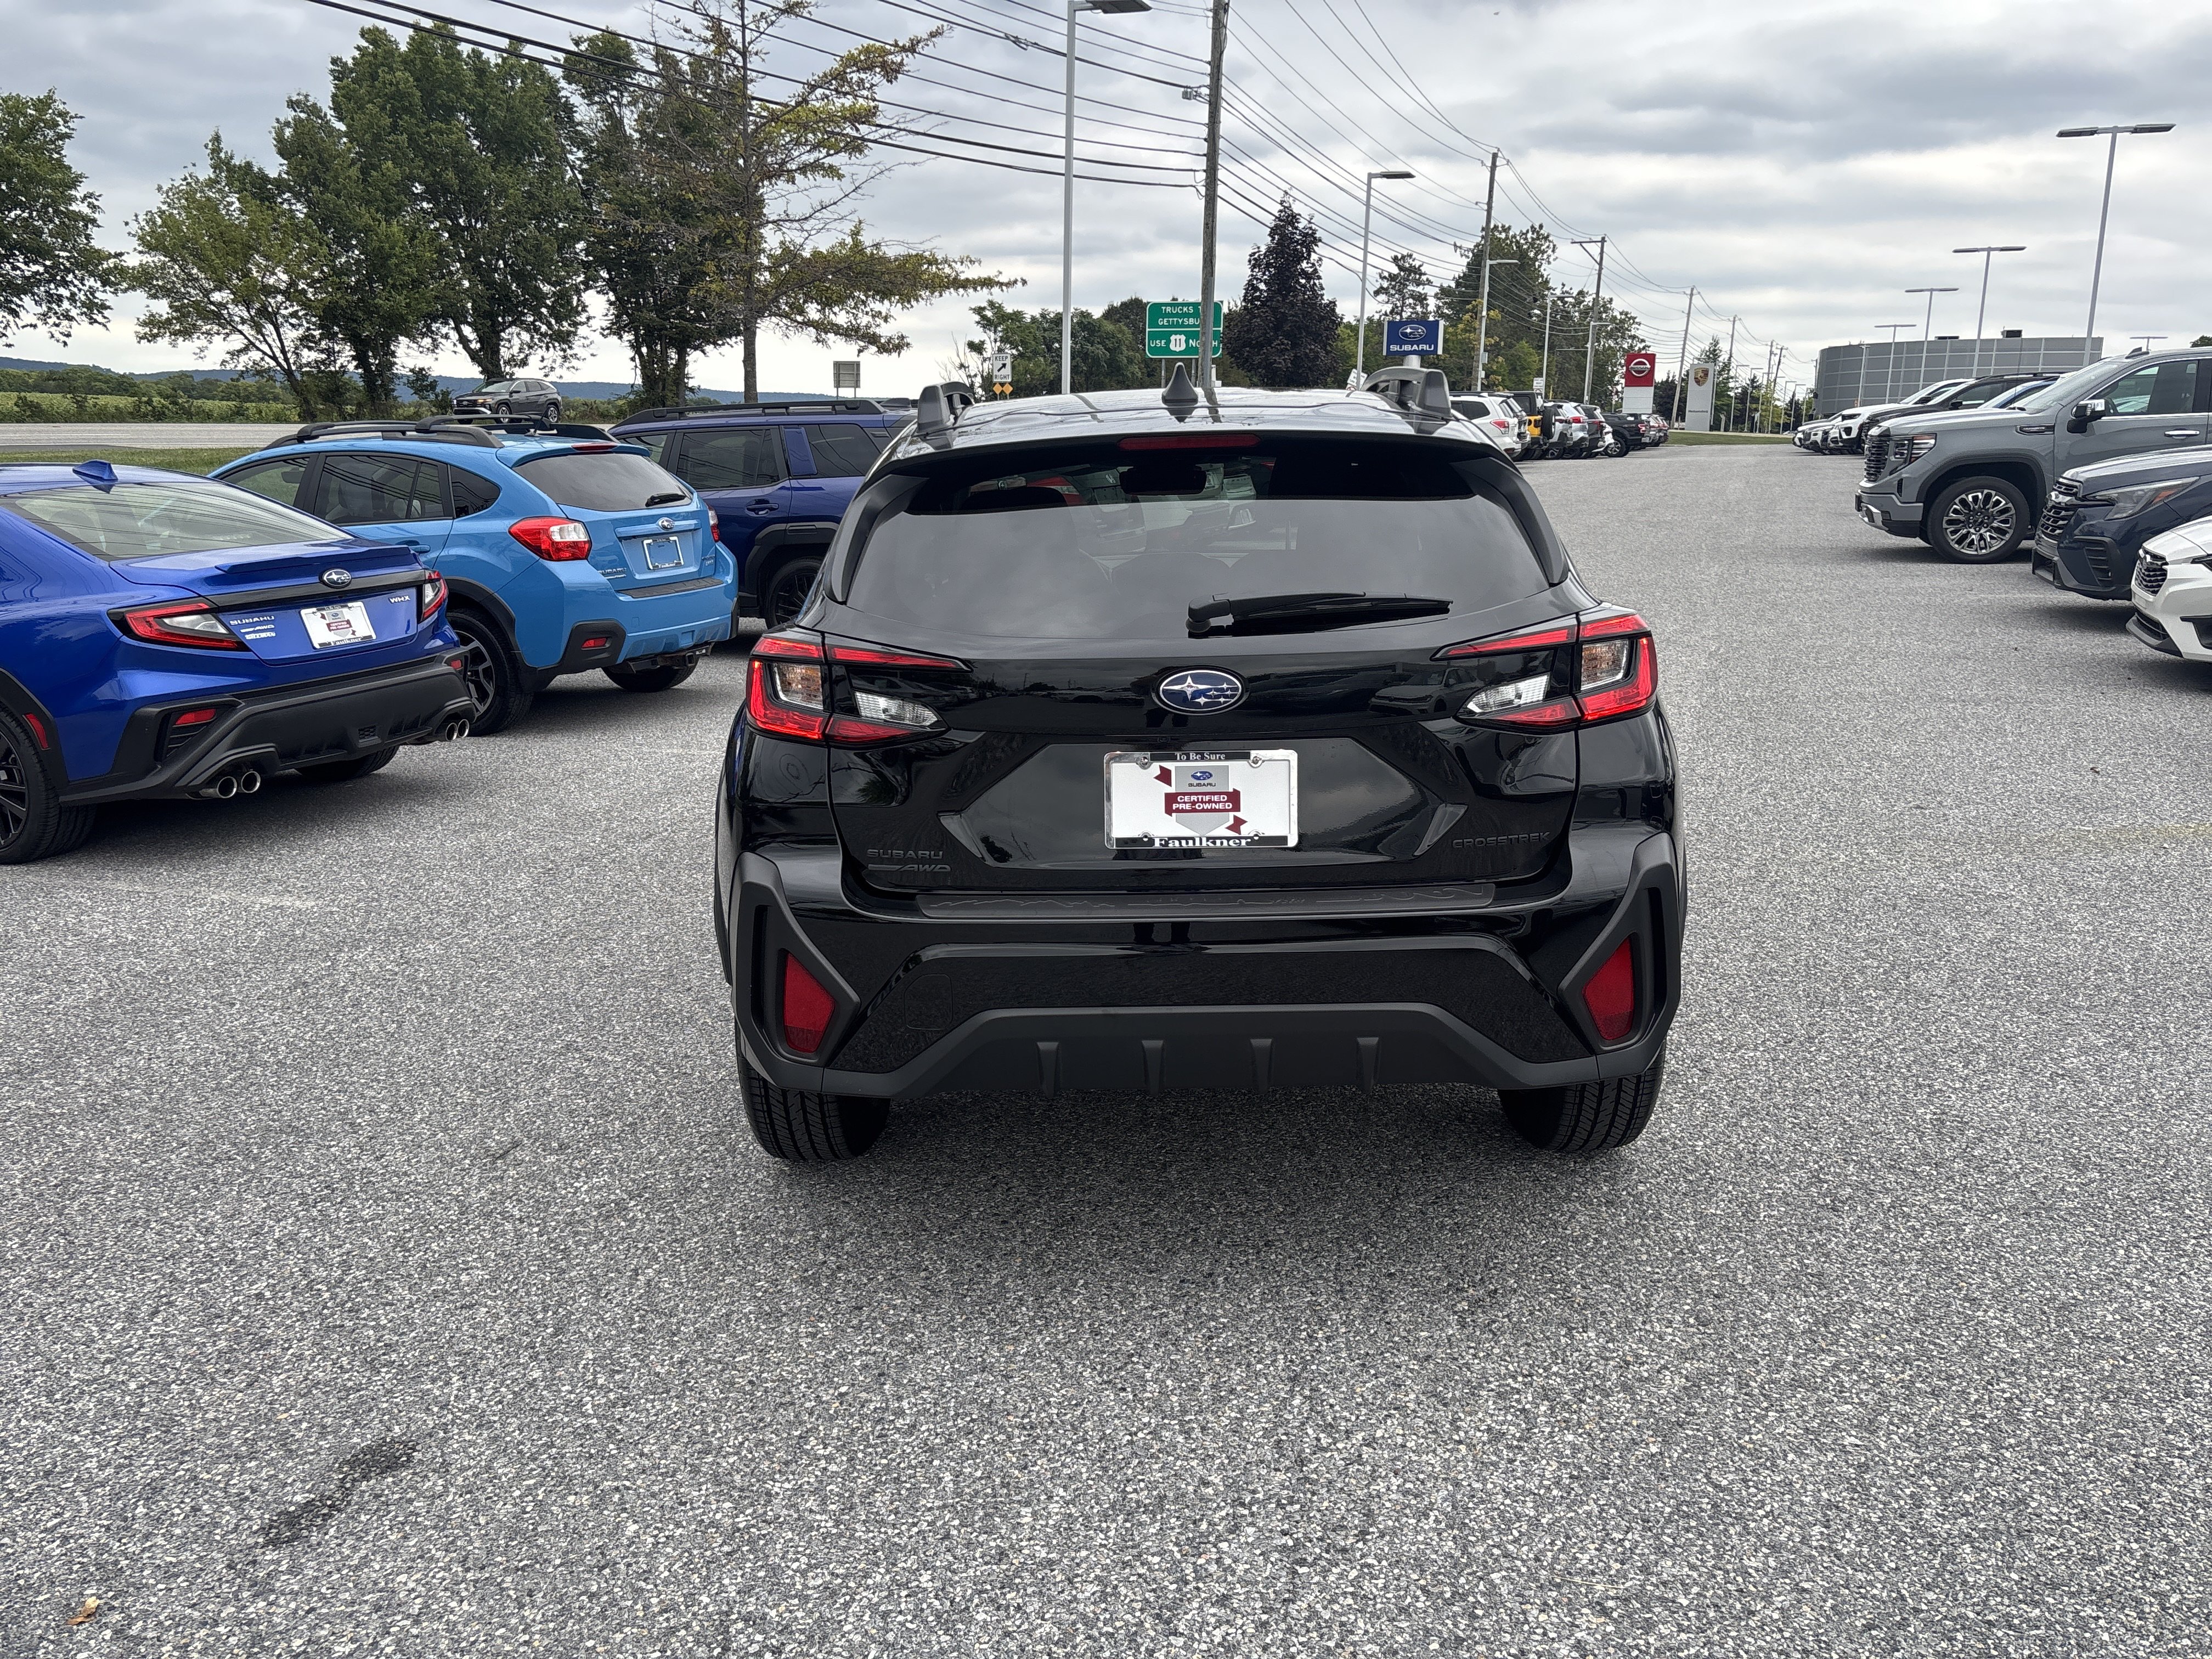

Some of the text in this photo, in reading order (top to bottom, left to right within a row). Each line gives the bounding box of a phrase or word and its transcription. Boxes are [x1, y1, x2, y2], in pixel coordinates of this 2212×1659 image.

[1174, 338, 1182, 348] 11
[389, 595, 411, 603] WRX
[229, 616, 275, 625] SUBARU
[1152, 836, 1251, 847] Faulkner
[1452, 832, 1550, 849] CROSSTREK
[866, 849, 944, 860] SUBARU
[896, 864, 952, 872] AWD
